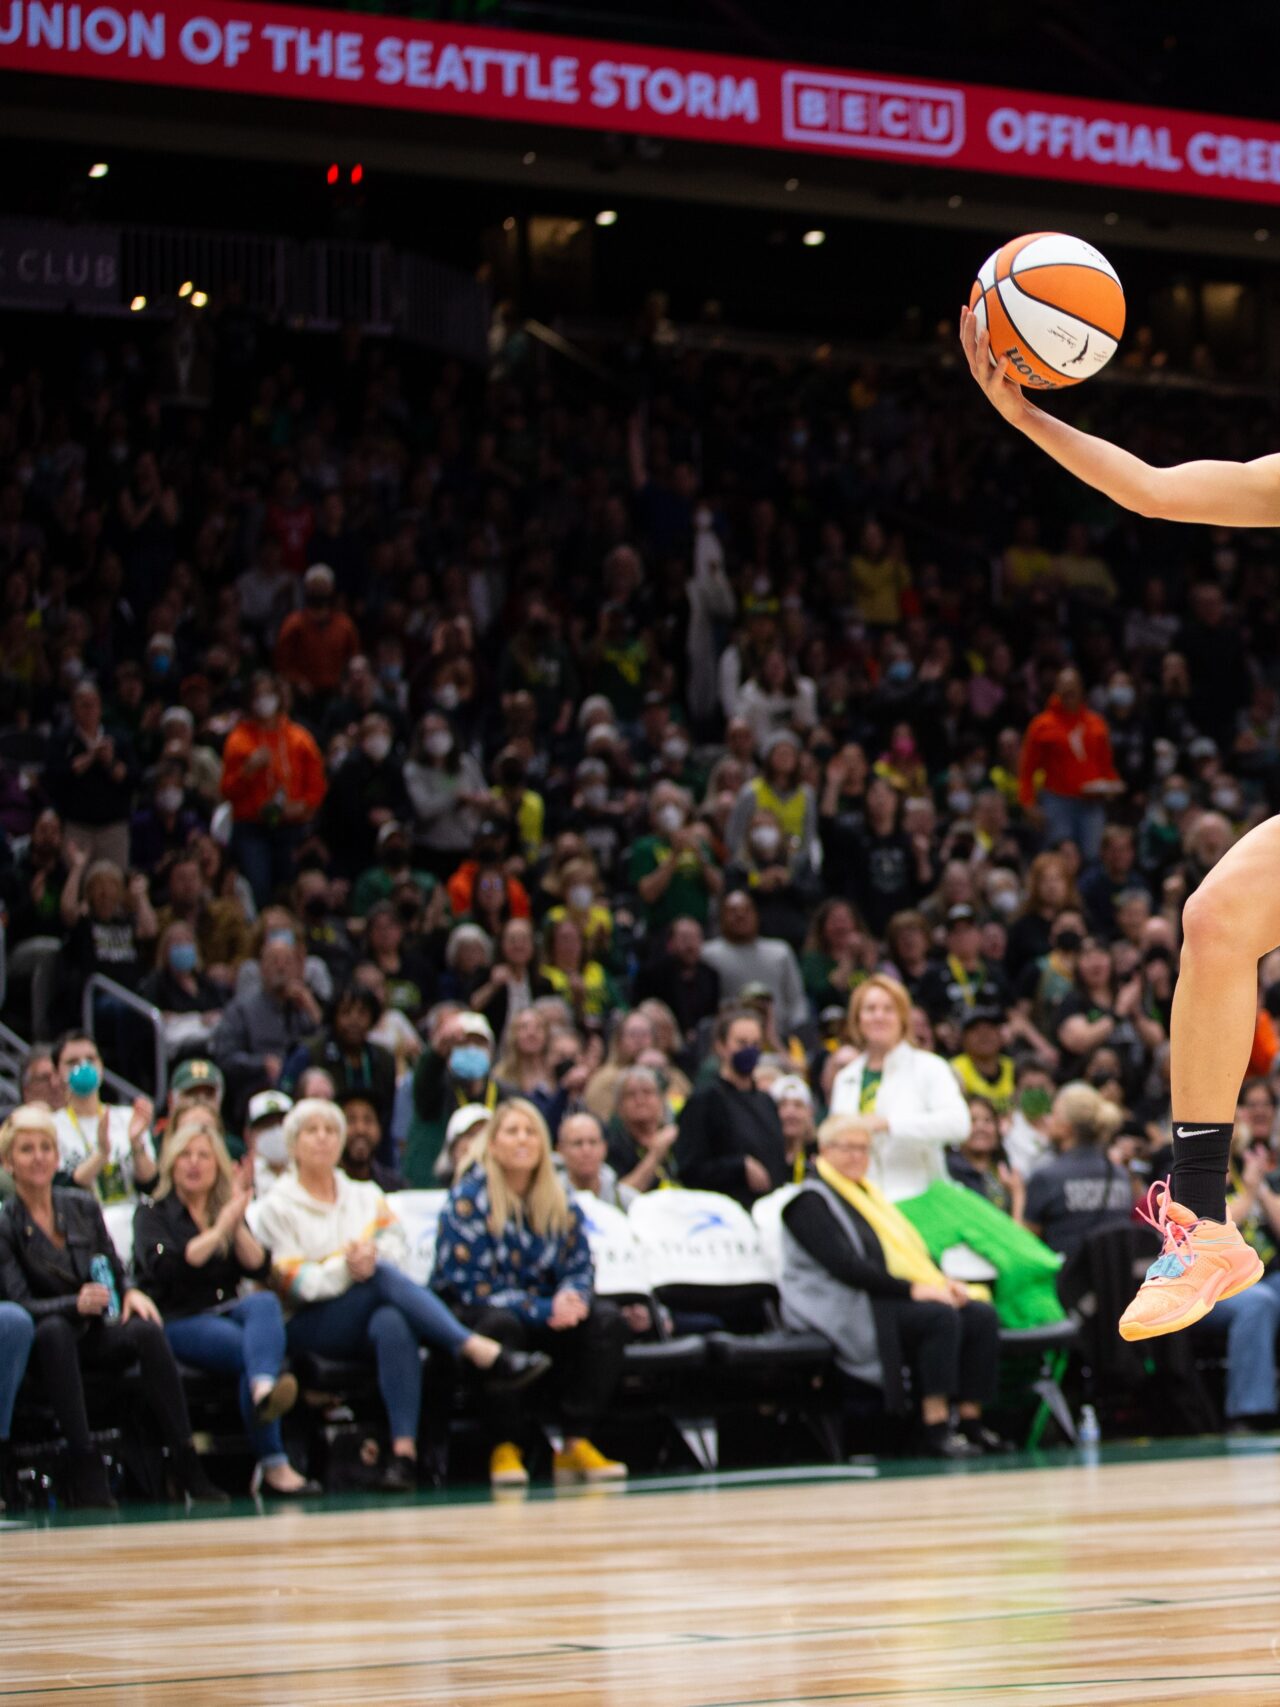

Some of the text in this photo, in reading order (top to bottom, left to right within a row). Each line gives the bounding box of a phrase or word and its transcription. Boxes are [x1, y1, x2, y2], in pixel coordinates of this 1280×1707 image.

[0, 0, 760, 123] UNION OF THE SEATTLE STORM
[798, 87, 953, 142] BECU
[987, 107, 1184, 172] OFFICIAL
[16, 248, 116, 288] CLUB
